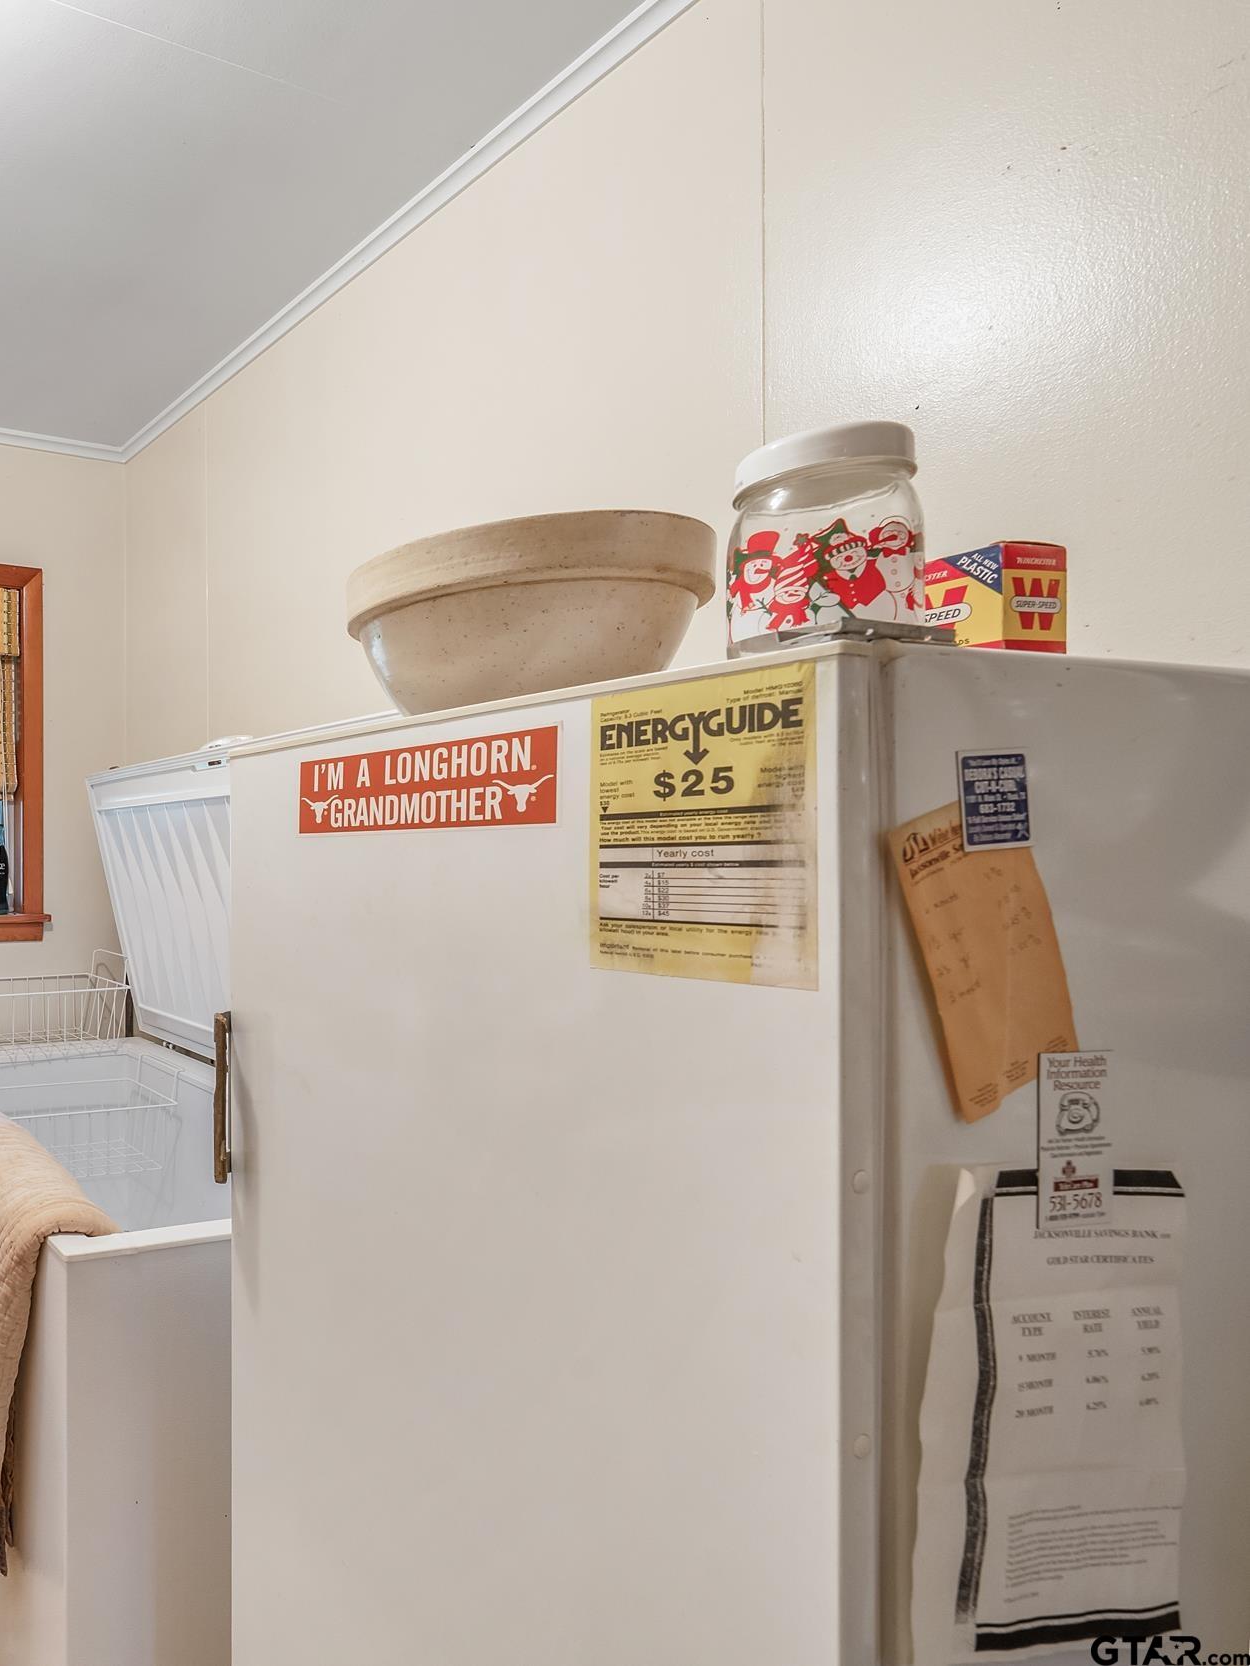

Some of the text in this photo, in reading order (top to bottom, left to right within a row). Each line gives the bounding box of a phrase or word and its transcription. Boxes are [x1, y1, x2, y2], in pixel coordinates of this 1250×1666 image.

[971, 553, 999, 570] ALL NEW
[956, 556, 999, 584] PLASTIC
[1015, 599, 1058, 610] SUPER-SPEED
[600, 697, 803, 754] ENERGYGUIDE
[314, 735, 532, 793] I'M A LONGHORN
[653, 766, 735, 802] $25
[330, 785, 503, 829] GRANDMOTHER
[657, 849, 715, 859] Yearly cost
[1046, 1055, 1107, 1069] Your Health
[1046, 1068, 1108, 1080] Information
[1053, 1080, 1101, 1092] Resource
[1049, 1192, 1103, 1213] 531-5678
[1034, 1230, 1092, 1240] JACKSONVILLE
[1047, 1255, 1155, 1266] GOLD STAR CERTIFICATES
